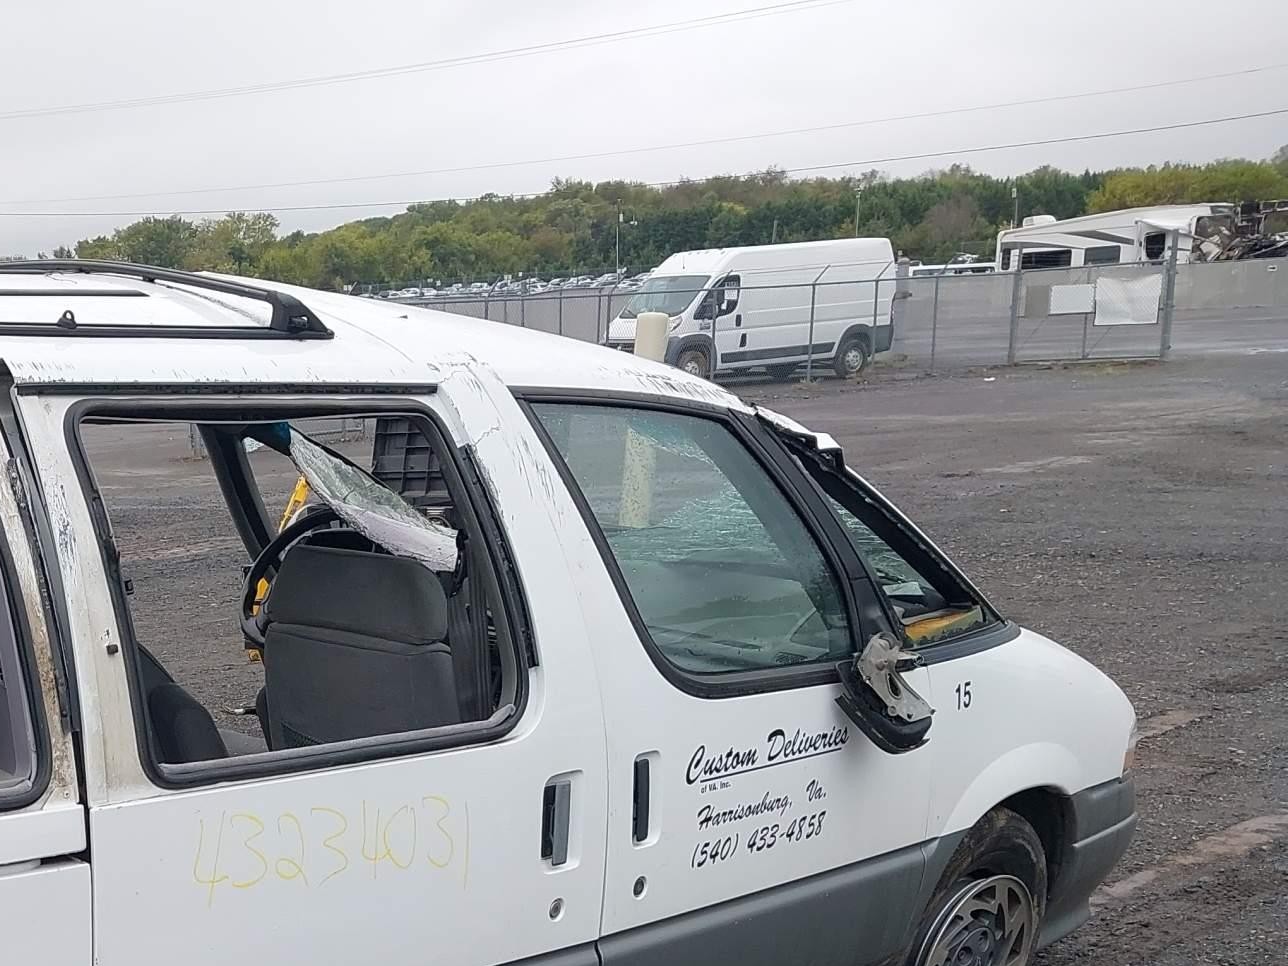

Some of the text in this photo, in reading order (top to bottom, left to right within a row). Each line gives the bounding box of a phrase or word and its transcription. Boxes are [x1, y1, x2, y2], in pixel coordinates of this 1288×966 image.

[955, 681, 972, 711] 15
[685, 725, 850, 785] Custom Deliveries
[696, 779, 828, 831] Harrisonburg, Va.
[193, 796, 470, 908] 43234031
[691, 811, 827, 869] (540) 433-4858
